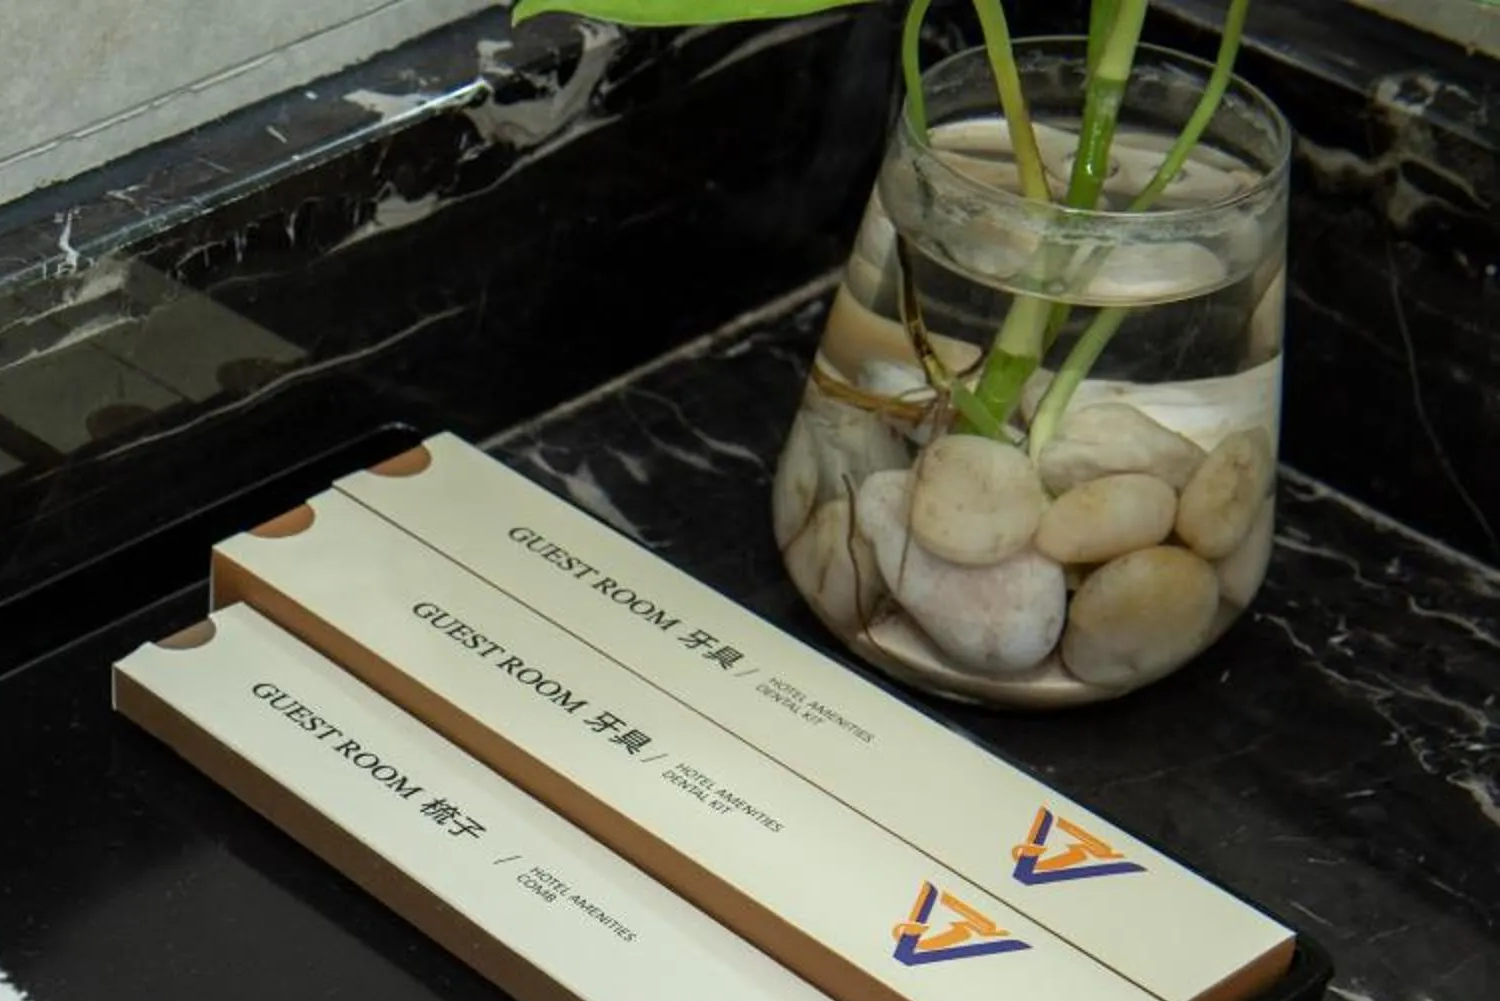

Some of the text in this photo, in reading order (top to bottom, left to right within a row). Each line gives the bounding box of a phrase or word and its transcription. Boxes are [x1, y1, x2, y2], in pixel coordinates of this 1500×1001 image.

[508, 526, 600, 579] GUEST
[592, 576, 682, 631] ROOM
[412, 602, 506, 658] GUEST
[495, 655, 590, 714] ROOM
[756, 684, 826, 726] DENTAL KIT
[768, 677, 875, 744] HOTEL AMENITIES
[252, 682, 343, 740] GUEST
[333, 739, 424, 800] ROOM
[419, 797, 487, 840] 梳子
[661, 769, 734, 815] DENTAL KIT
[675, 762, 785, 833] HOTEL AMENITIES
[516, 873, 558, 904] COMB
[529, 866, 638, 943] HOTEL AMENITIES
